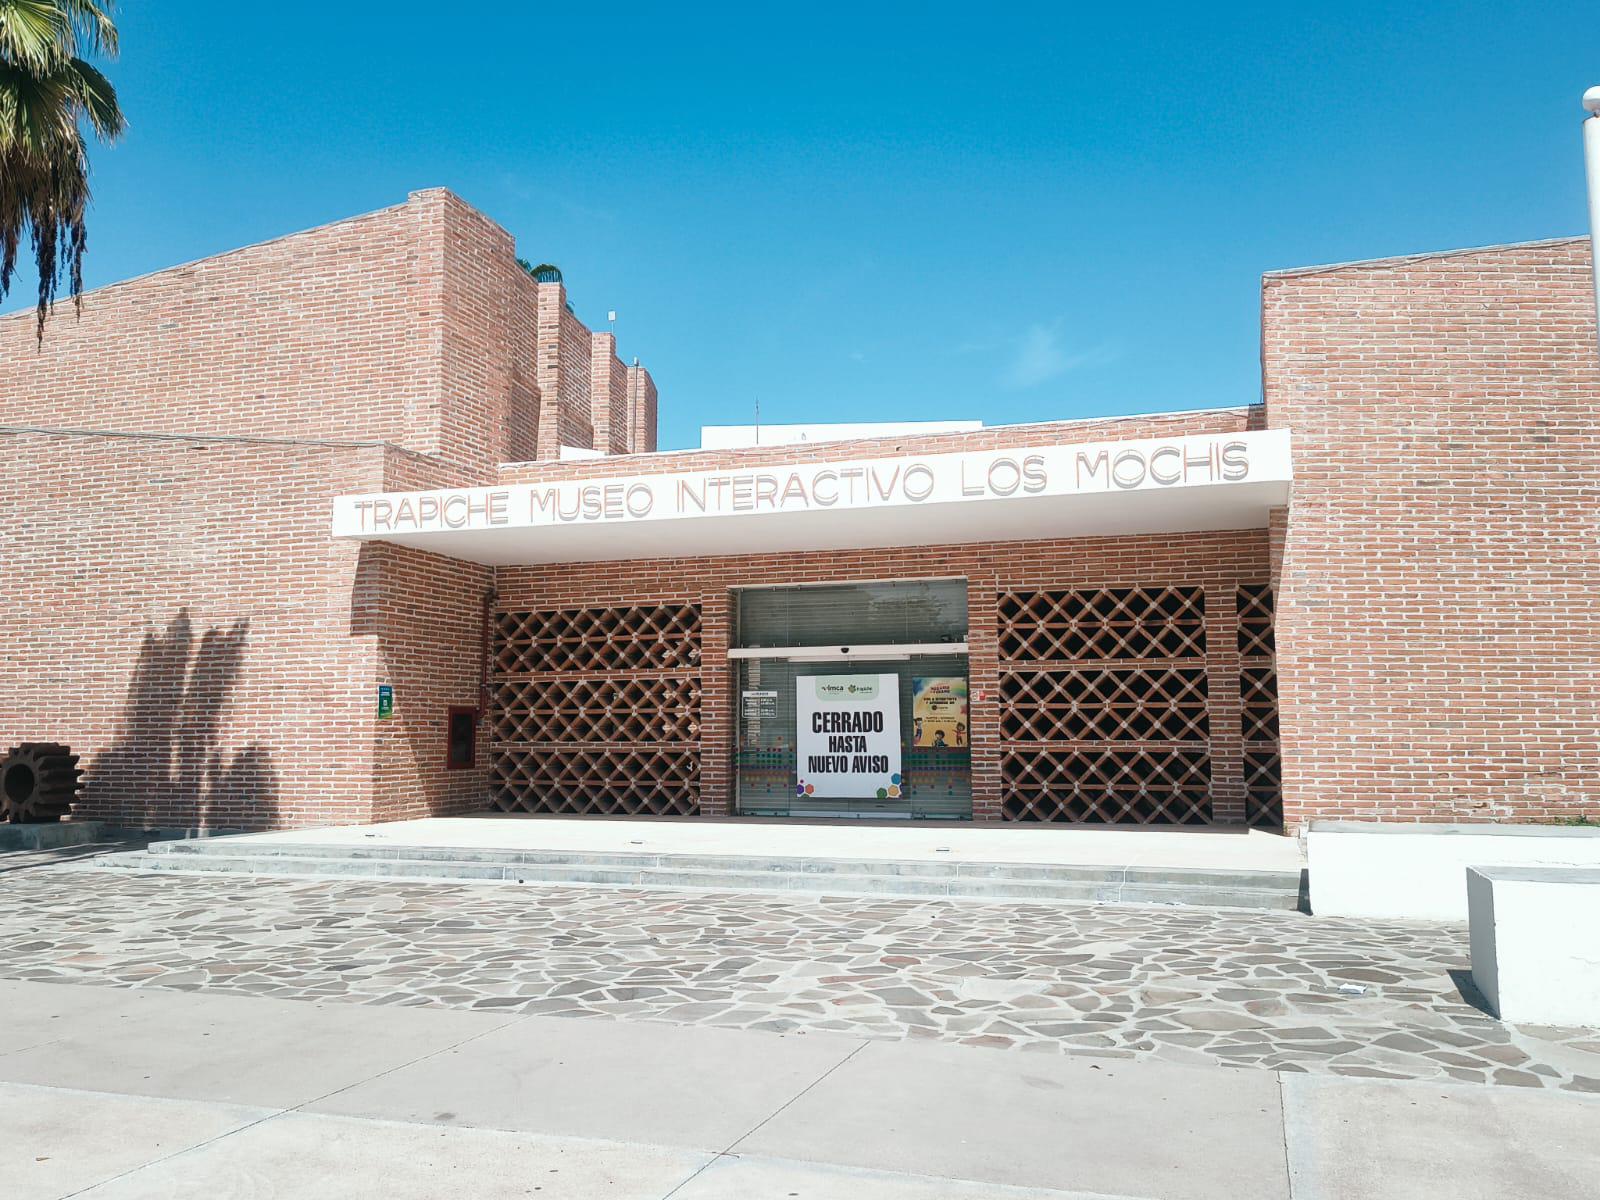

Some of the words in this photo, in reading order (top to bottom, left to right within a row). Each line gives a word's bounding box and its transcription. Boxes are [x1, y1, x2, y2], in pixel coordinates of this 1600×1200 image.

[354, 491, 509, 531] TRAPICHE
[530, 483, 653, 522] MUSEO
[677, 463, 935, 513] INTERACTIVO
[961, 455, 1048, 496] LOS
[1076, 441, 1249, 490] MOCHIS
[812, 711, 883, 733] CERRADO
[828, 735, 867, 753] HASTA
[808, 755, 848, 773] NUEVO
[852, 755, 889, 773] AVISO
